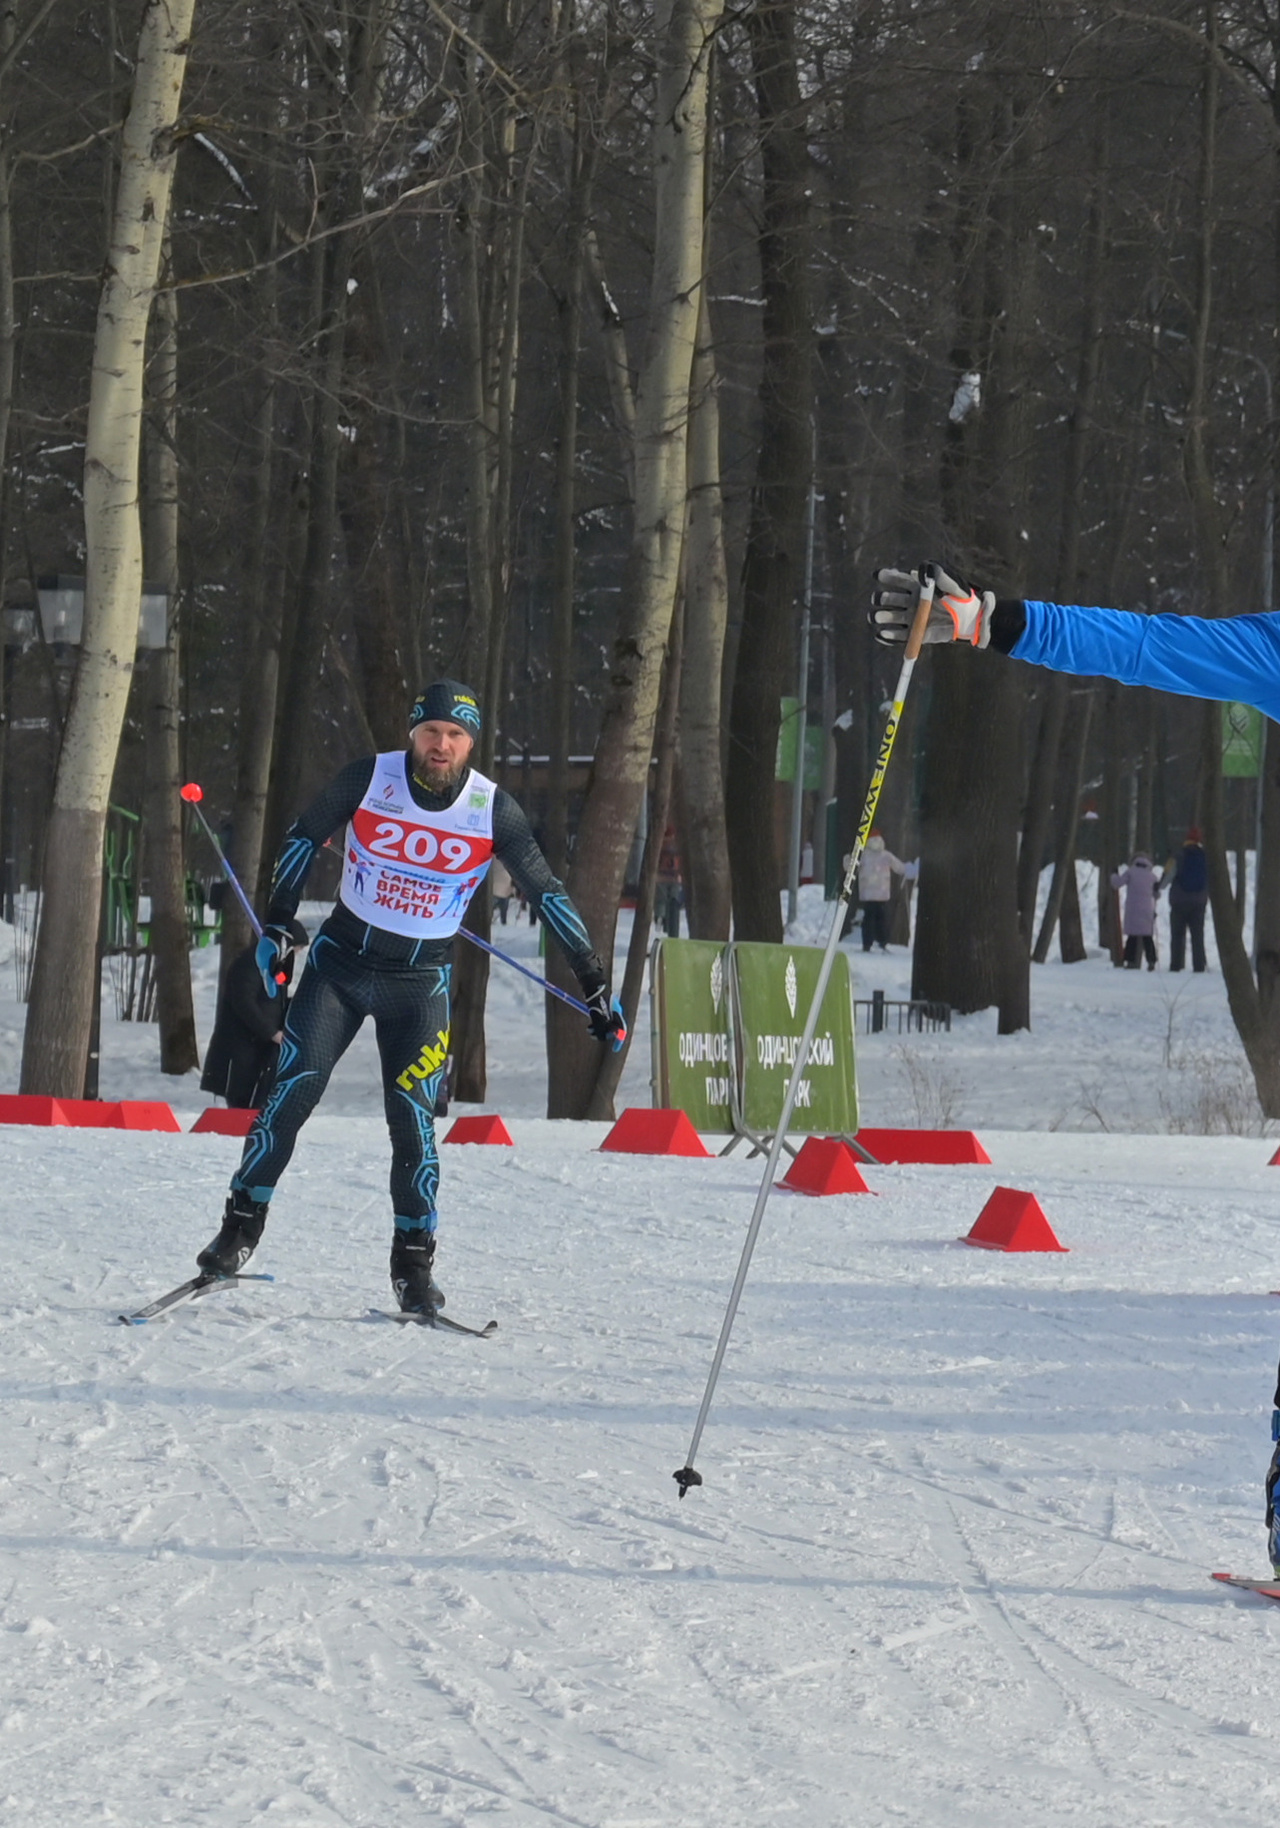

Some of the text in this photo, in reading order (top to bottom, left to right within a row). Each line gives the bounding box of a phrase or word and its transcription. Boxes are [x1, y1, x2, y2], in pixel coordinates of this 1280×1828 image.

[857, 719, 897, 845] ONE WAY
[369, 822, 472, 871] 209
[376, 879, 440, 905] ВРЕМЯ
[380, 870, 442, 892] САМОЕ
[373, 892, 434, 919] ЖИТЬ
[757, 1031, 834, 1070] ОДИНЦОСКИЙ
[783, 1079, 811, 1108] ПРК
